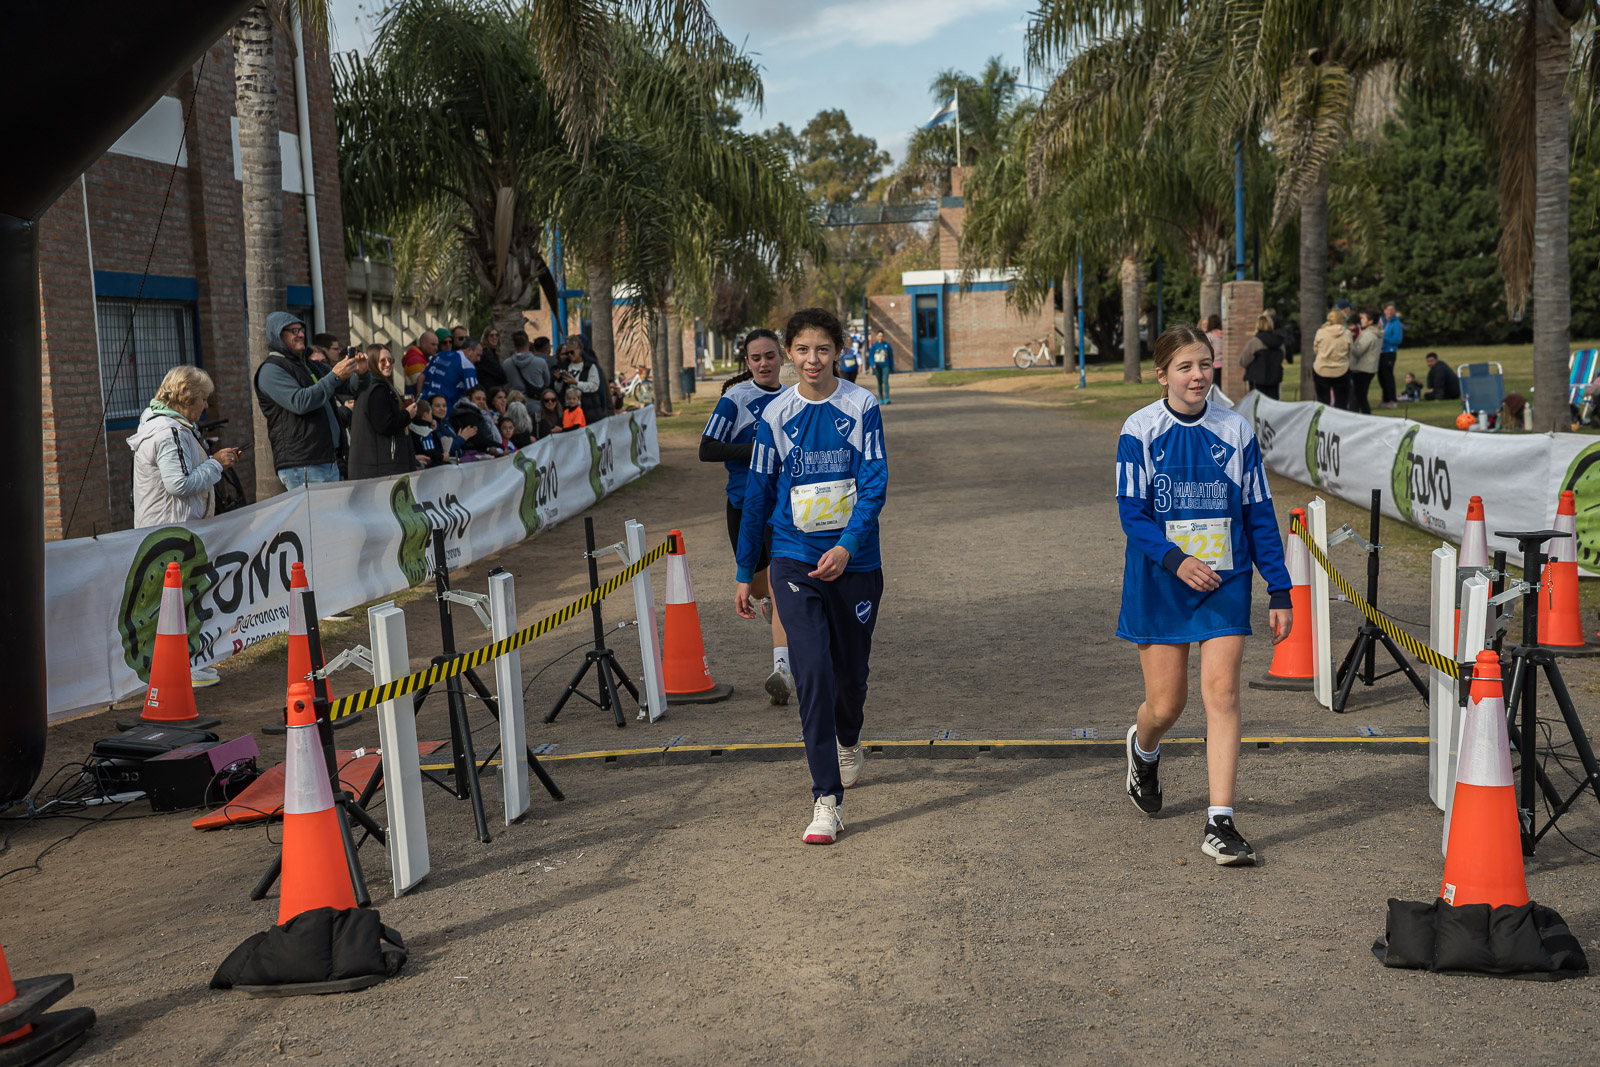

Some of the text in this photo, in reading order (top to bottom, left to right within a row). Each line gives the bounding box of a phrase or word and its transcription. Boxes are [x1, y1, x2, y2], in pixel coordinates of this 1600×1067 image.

[805, 448, 851, 464] MARATÓN
[1153, 473, 1228, 513] 3 MARATÓN
[798, 494, 852, 522] 724
[1174, 533, 1226, 559] 723
